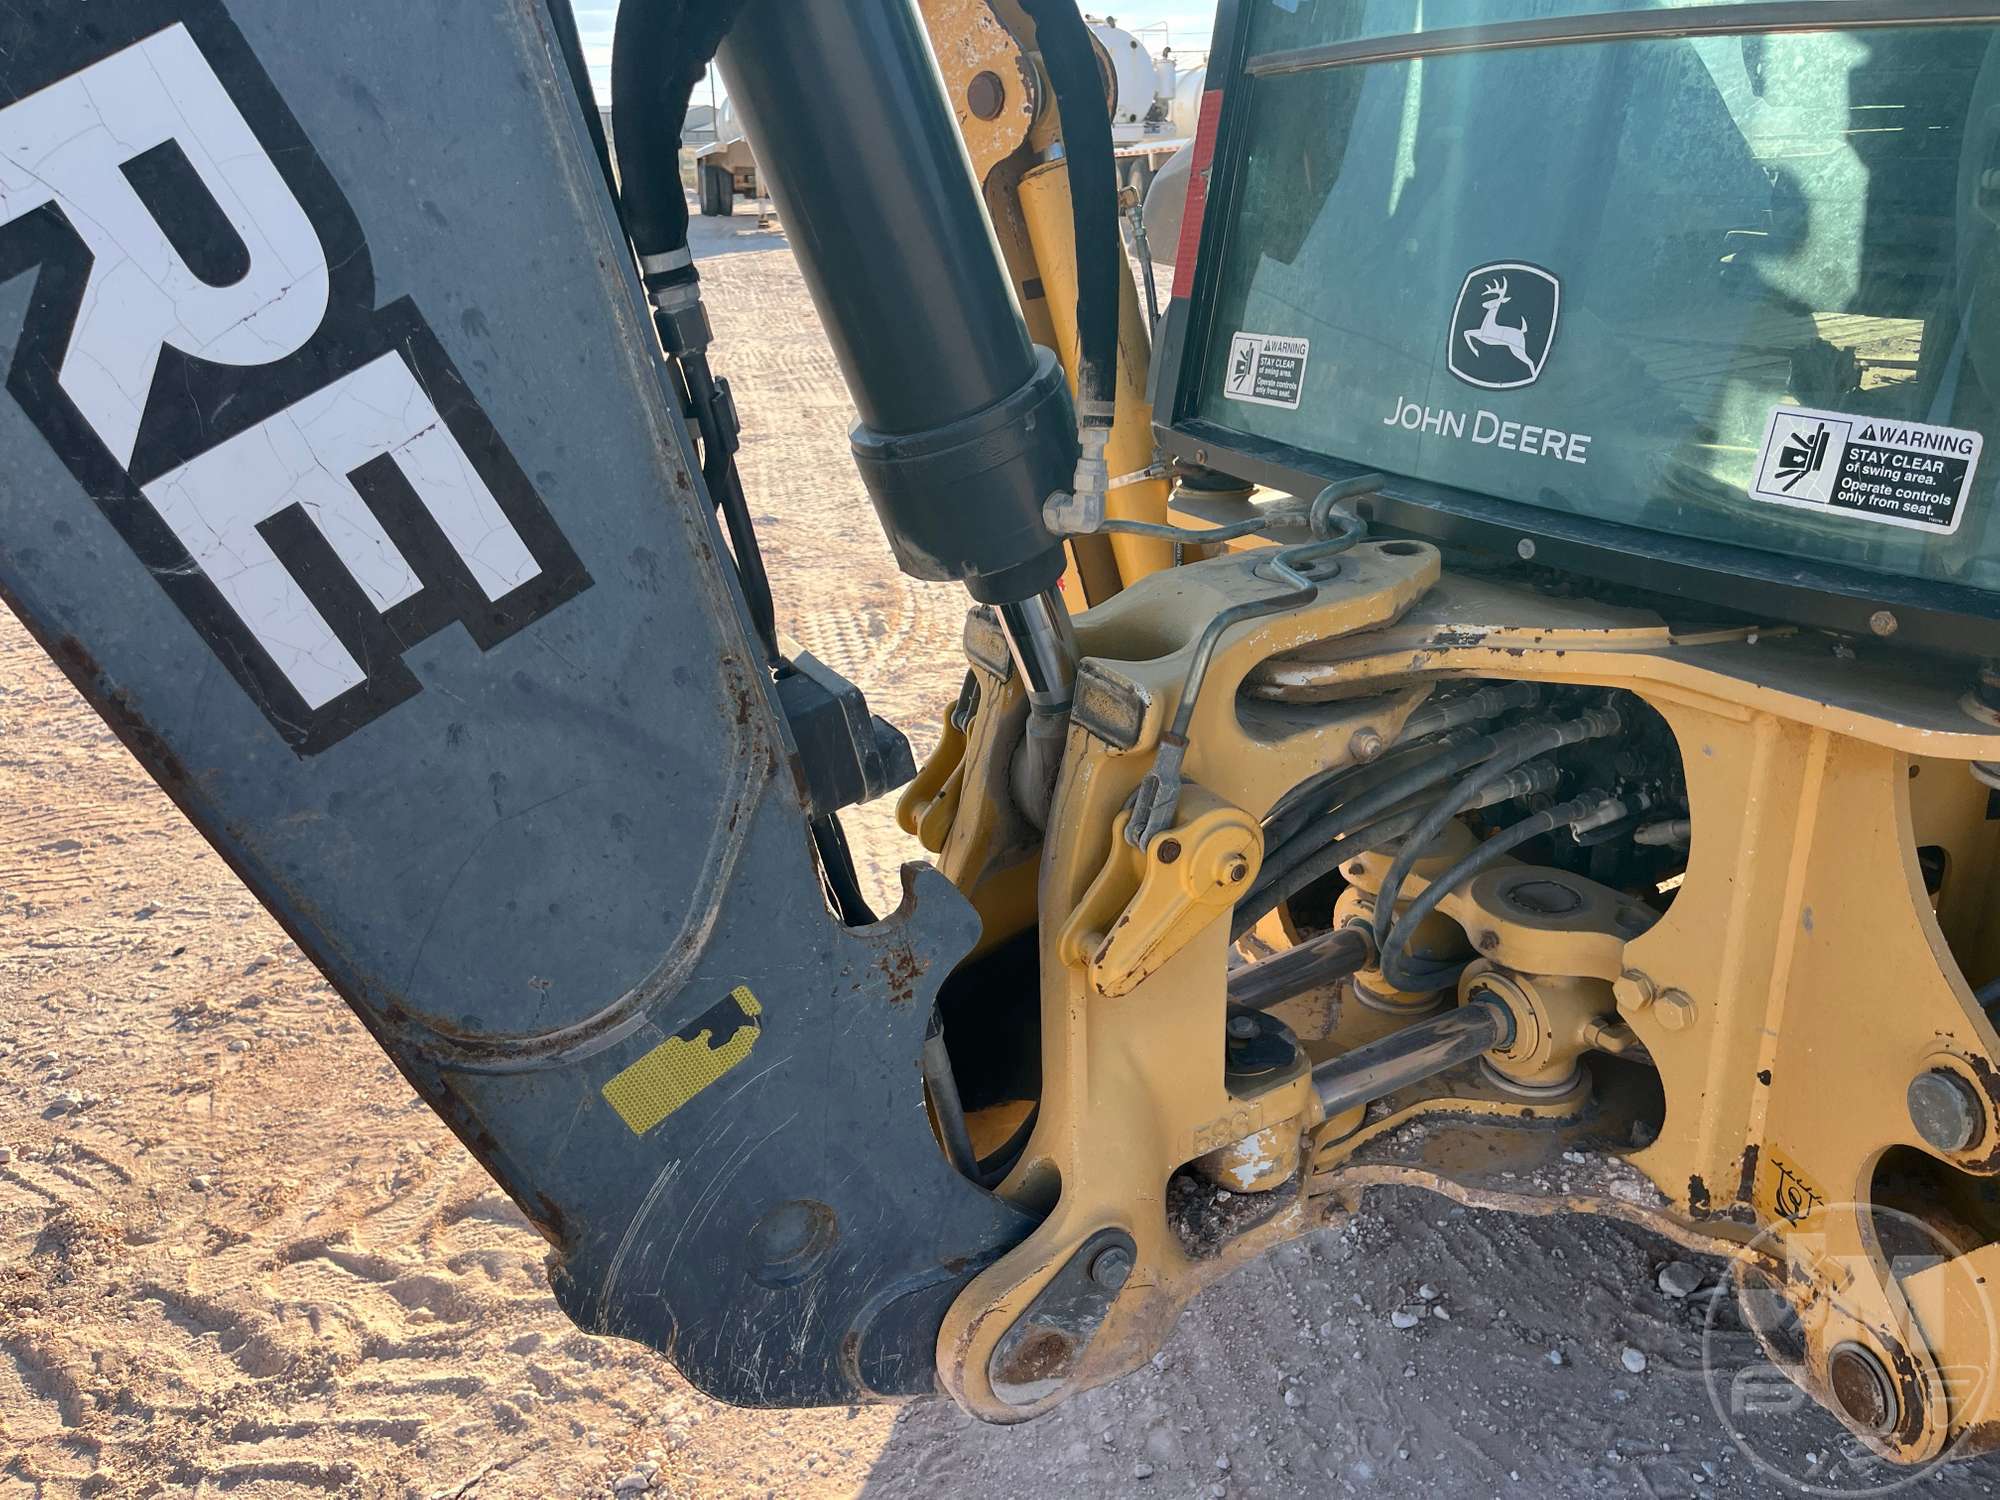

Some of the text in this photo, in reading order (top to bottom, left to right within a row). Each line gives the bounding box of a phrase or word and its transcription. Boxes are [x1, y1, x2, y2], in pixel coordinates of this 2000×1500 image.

[1271, 341, 1305, 355] WARNING
[0, 21, 542, 711] RE
[1260, 357, 1295, 370] STAY CLEAR
[1276, 381, 1297, 391] controls
[1384, 396, 1592, 464] JOHN DEERE
[1879, 426, 1973, 455] WARNING
[1849, 448, 1944, 473] STAY CLEAR
[1845, 462, 1937, 486] of swing area.
[1837, 490, 1935, 516] only from seat.
[1841, 477, 1952, 506] Operate controls
